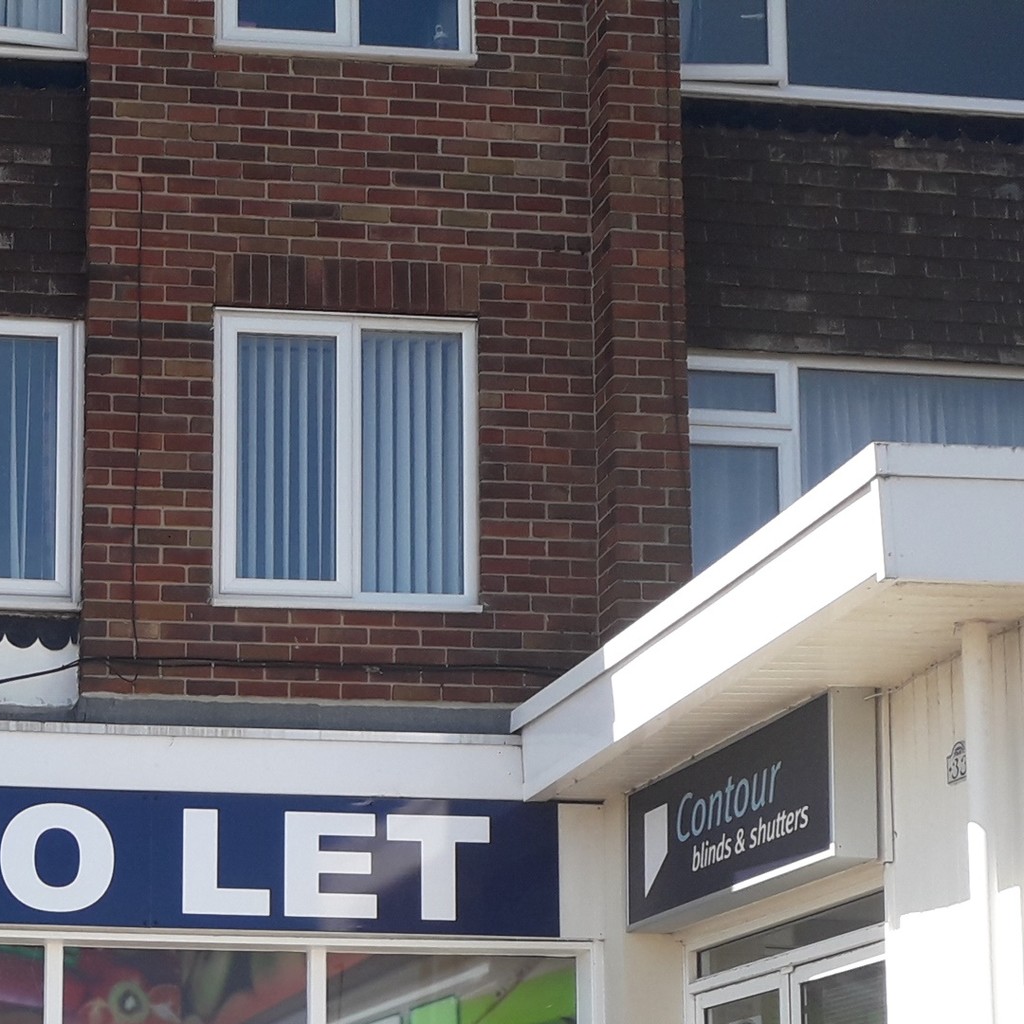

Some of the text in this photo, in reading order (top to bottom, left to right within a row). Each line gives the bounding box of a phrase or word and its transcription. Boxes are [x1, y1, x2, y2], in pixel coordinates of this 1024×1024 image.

[677, 760, 783, 843] Contour
[691, 805, 810, 872] blinds & shutters
[182, 808, 491, 922] LET
